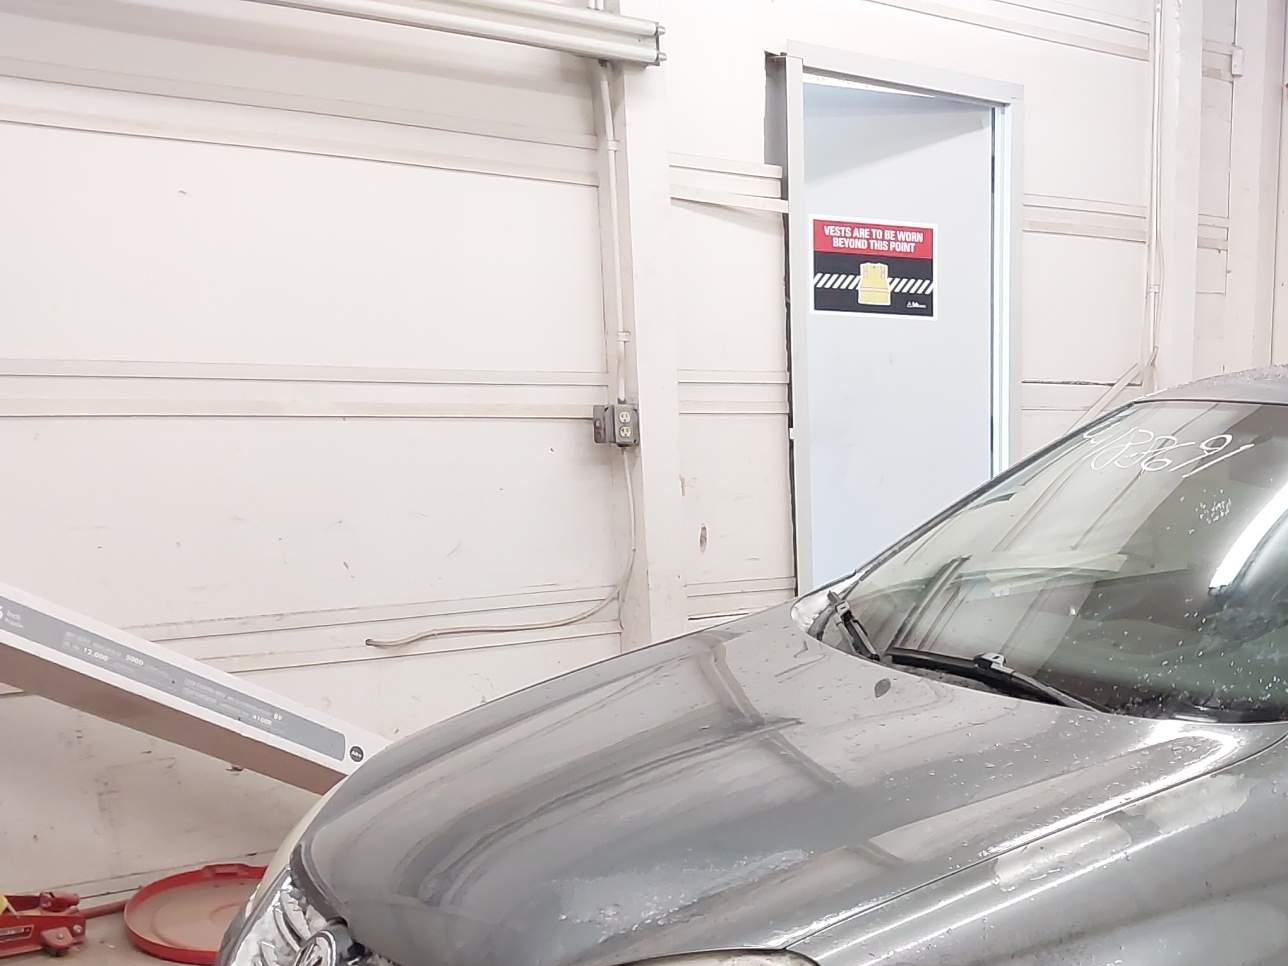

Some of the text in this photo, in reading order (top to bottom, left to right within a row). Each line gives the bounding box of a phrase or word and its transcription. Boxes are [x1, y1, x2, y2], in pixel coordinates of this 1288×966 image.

[824, 225, 923, 243] VESTS ARE TO BE WORN
[833, 237, 916, 252] BEYOND THIS POINT
